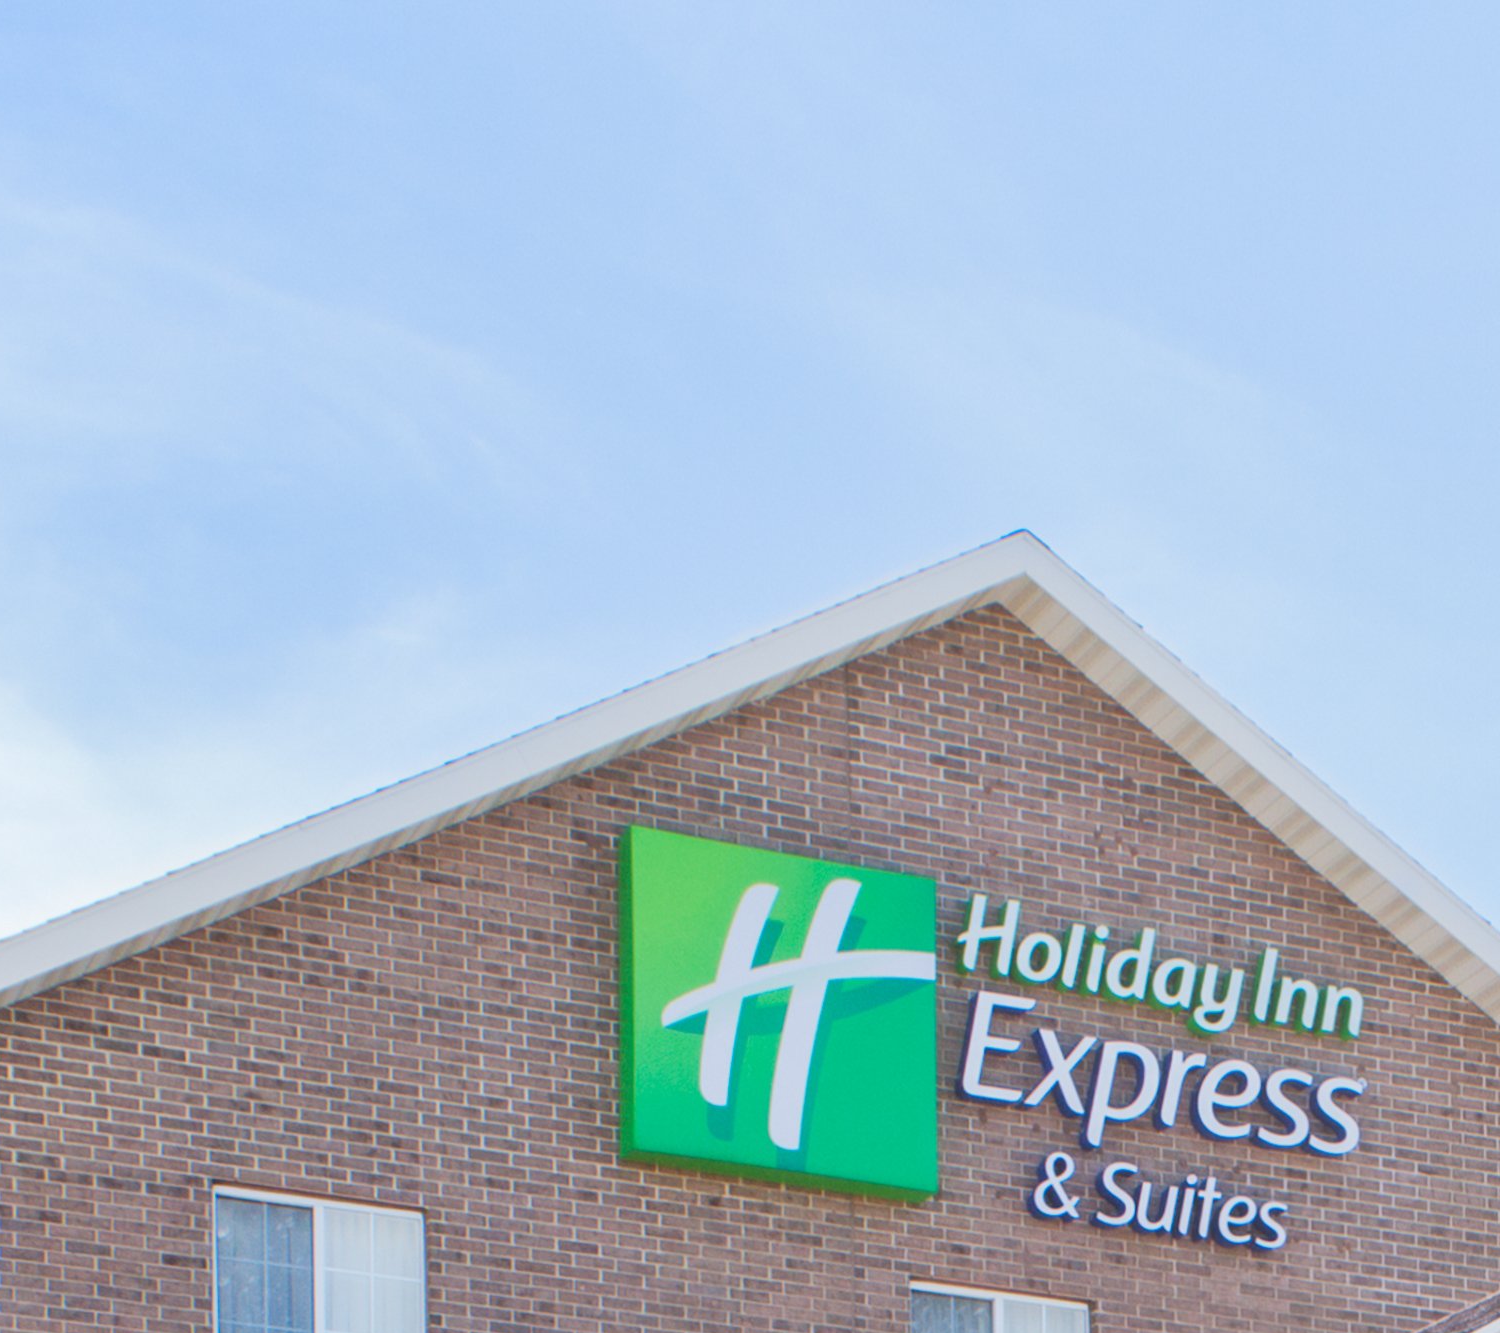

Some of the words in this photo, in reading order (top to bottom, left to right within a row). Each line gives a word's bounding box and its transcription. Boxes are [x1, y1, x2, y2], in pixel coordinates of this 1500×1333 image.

[958, 893, 1246, 1033] Holiday
[1254, 947, 1365, 1037] Inn
[960, 990, 1363, 1156] Express
[1034, 1152, 1080, 1220] &
[1098, 1163, 1289, 1250] Suites
